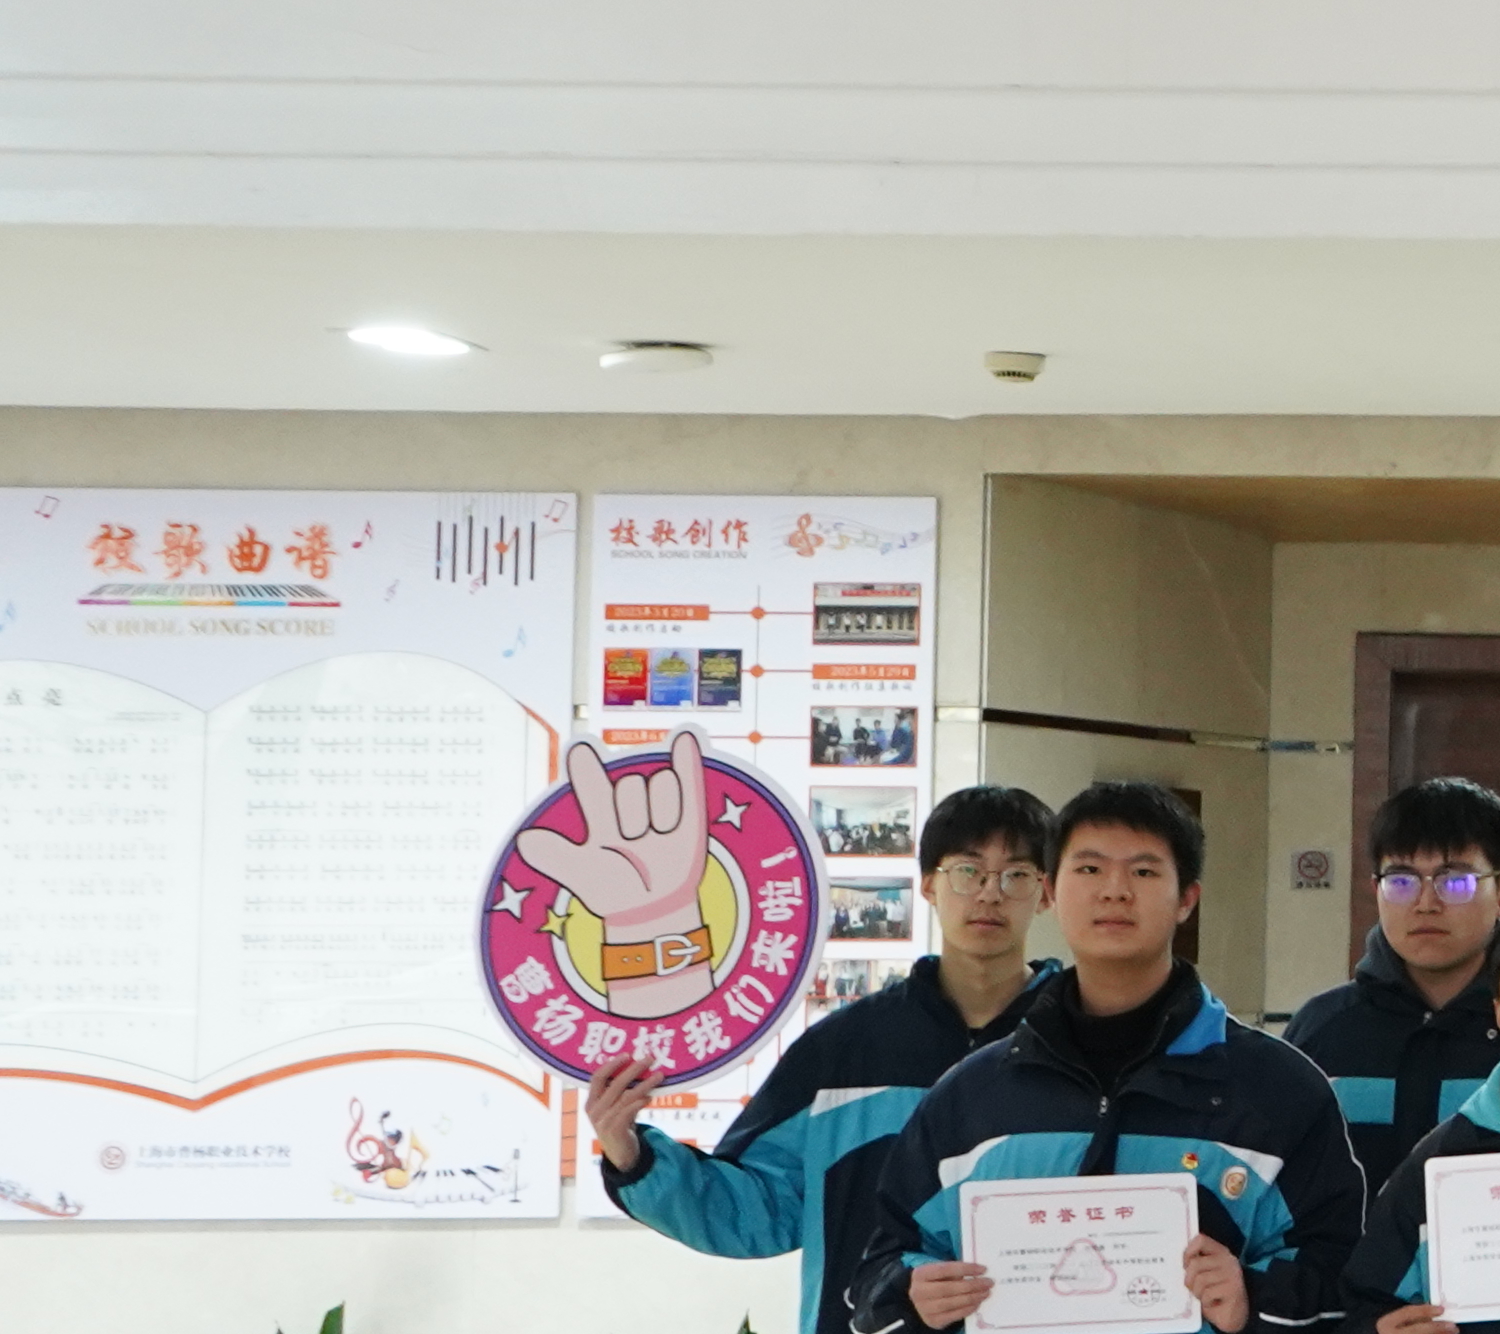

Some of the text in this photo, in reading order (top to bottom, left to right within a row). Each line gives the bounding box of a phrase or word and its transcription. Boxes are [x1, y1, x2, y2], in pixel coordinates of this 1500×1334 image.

[609, 519, 749, 550] 校歌创作
[611, 549, 747, 560] SCHOOL SONG CREATION
[87, 618, 335, 636] SCHOOL SONG SCORE
